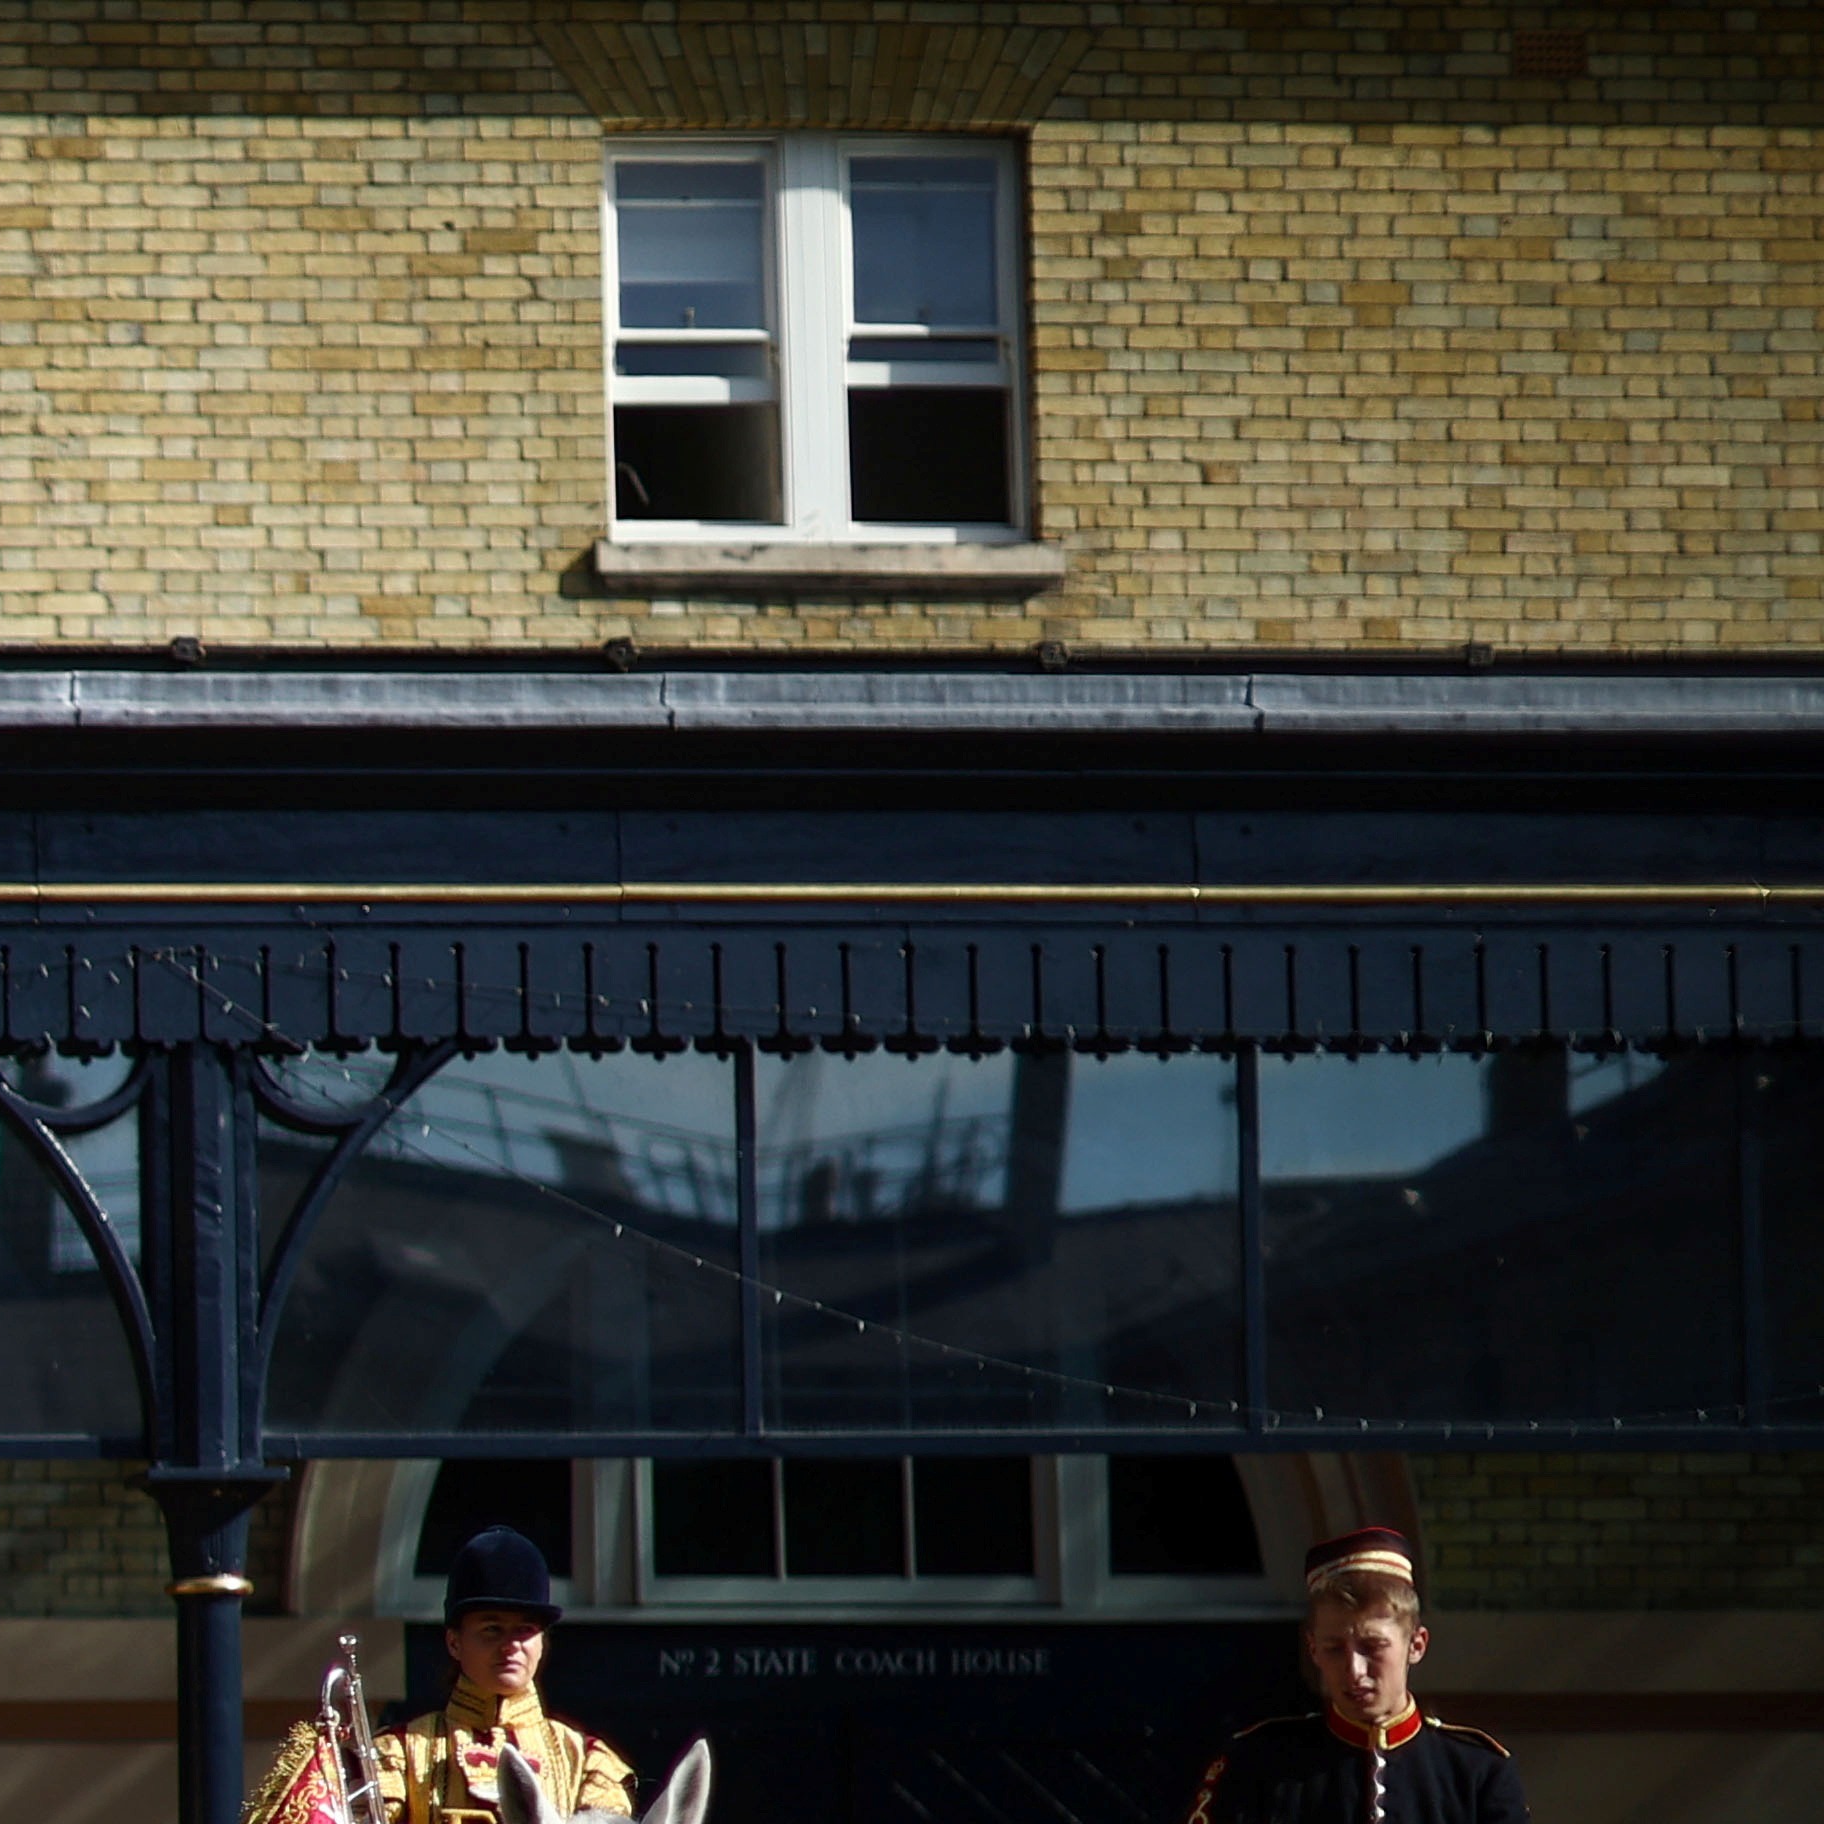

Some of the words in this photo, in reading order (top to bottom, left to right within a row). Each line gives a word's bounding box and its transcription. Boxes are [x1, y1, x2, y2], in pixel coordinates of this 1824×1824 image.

[704, 1648, 722, 1678] 2
[733, 1647, 818, 1678] STATE
[834, 1647, 937, 1677] COACH
[950, 1647, 1052, 1677] HOUSE
